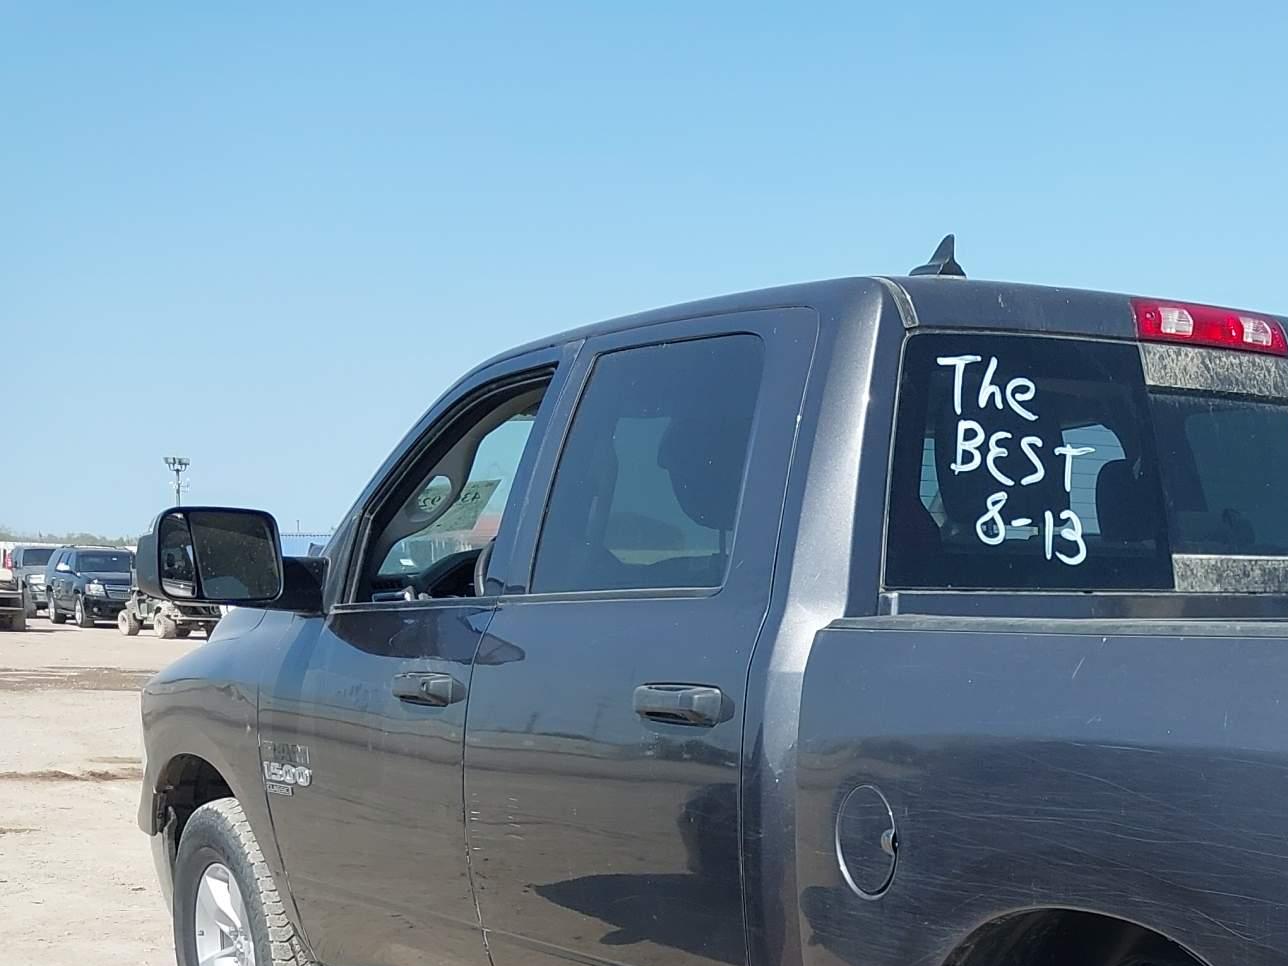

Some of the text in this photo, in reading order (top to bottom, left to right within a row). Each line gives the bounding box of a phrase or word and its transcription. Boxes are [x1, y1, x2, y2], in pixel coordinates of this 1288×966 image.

[936, 354, 1039, 421] The
[950, 420, 1096, 492] BEST
[975, 491, 1087, 566] 8-13
[263, 760, 313, 787] 1500
